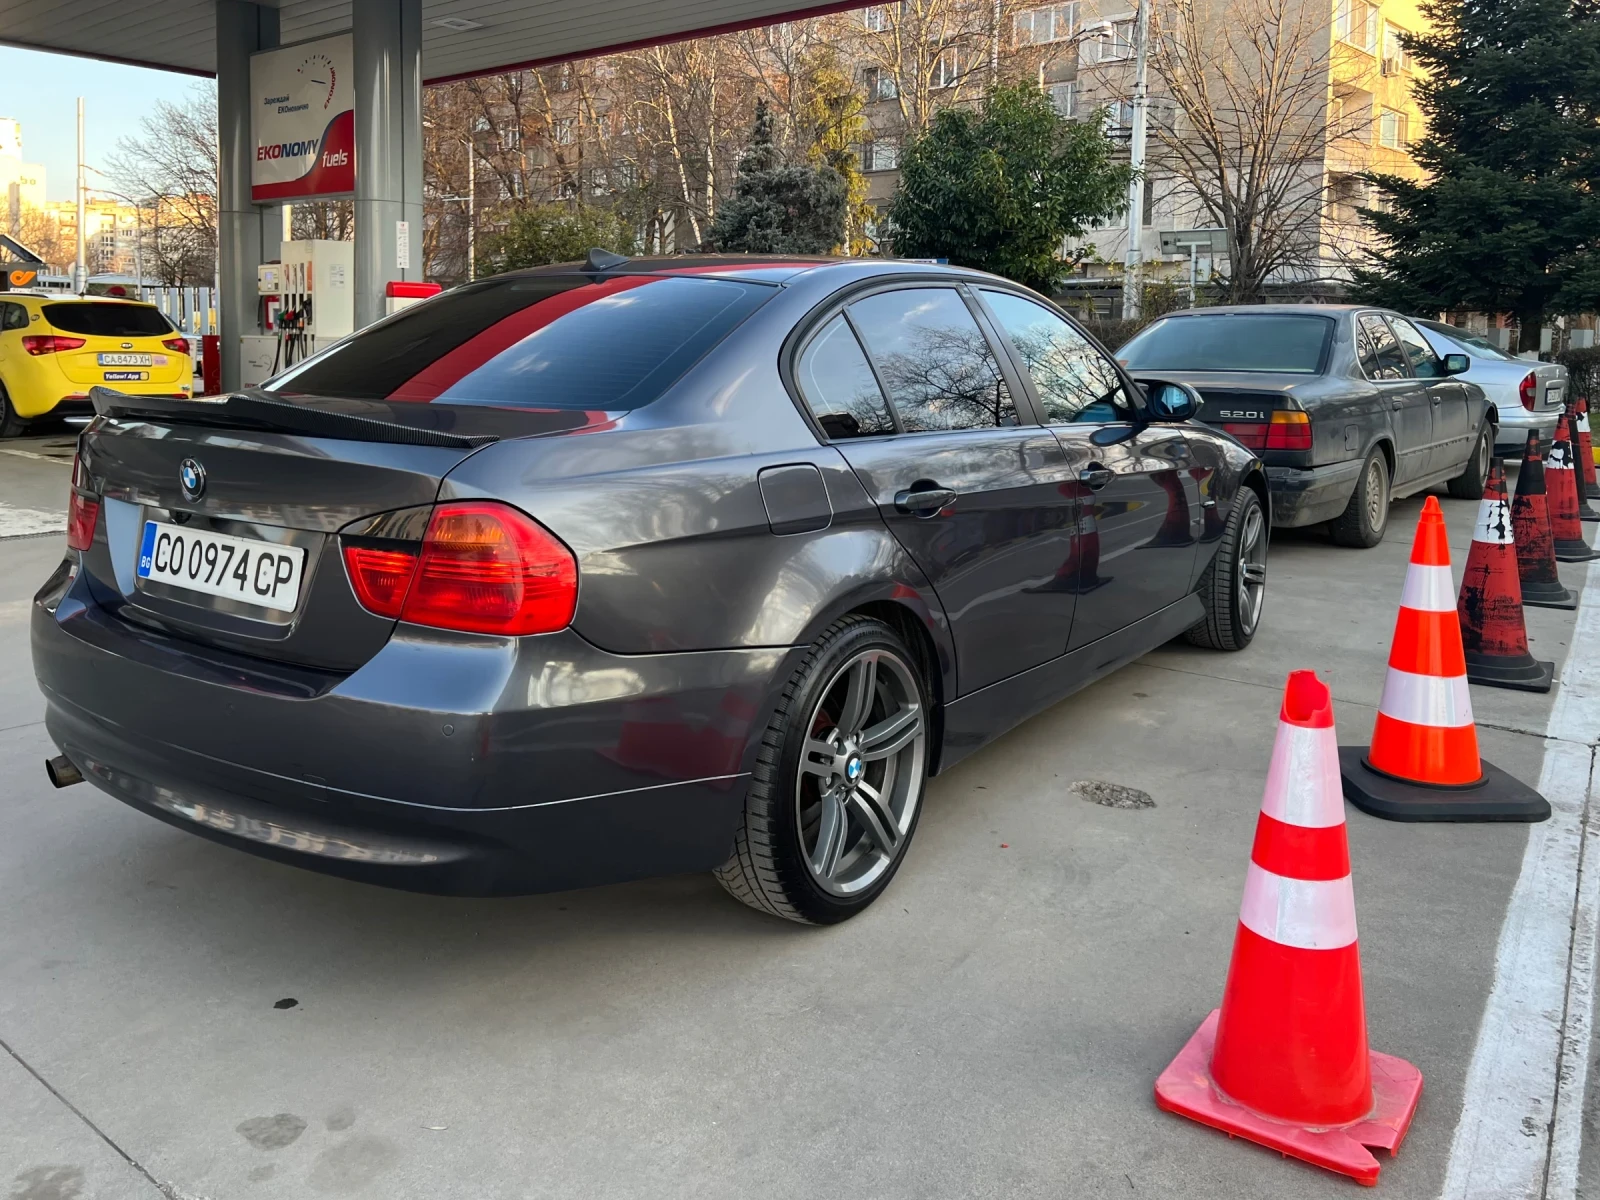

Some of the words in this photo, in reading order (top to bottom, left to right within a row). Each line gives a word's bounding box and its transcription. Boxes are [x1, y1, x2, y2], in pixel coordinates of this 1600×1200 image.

[324, 66, 336, 110] EKONOMY
[263, 94, 290, 106] Зареждай
[256, 138, 319, 161] EKONOMY
[322, 148, 348, 168] fuels
[1219, 410, 1265, 419] 520i
[141, 555, 151, 568] BG
[155, 532, 185, 576] CO
[188, 539, 251, 592] 0974
[253, 552, 294, 598] CP
